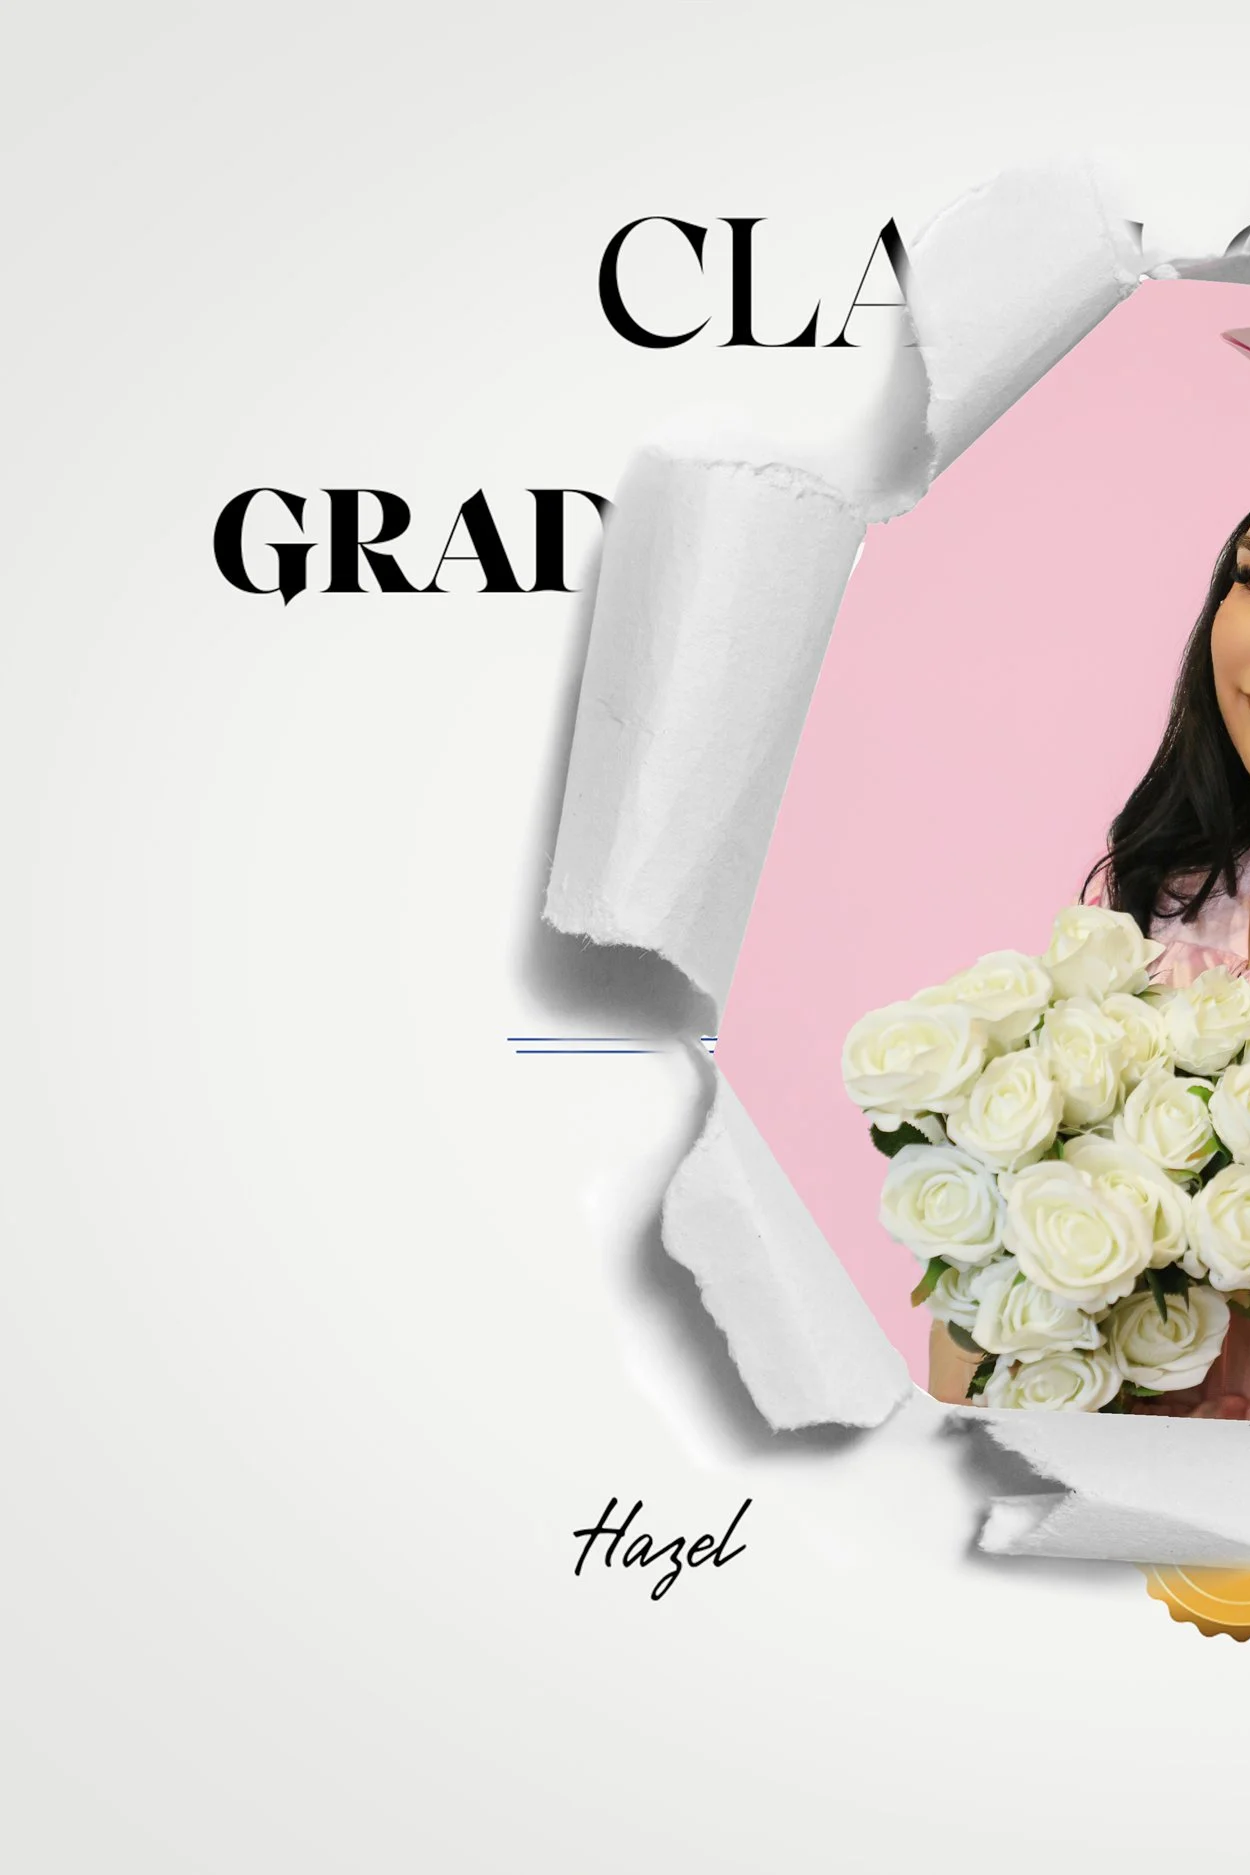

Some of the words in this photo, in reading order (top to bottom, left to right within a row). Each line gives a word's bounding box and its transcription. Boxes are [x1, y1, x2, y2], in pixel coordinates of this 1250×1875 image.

[598, 215, 1145, 349] CLA
[213, 487, 615, 607] GRAD
[572, 1497, 753, 1601] Hazel
